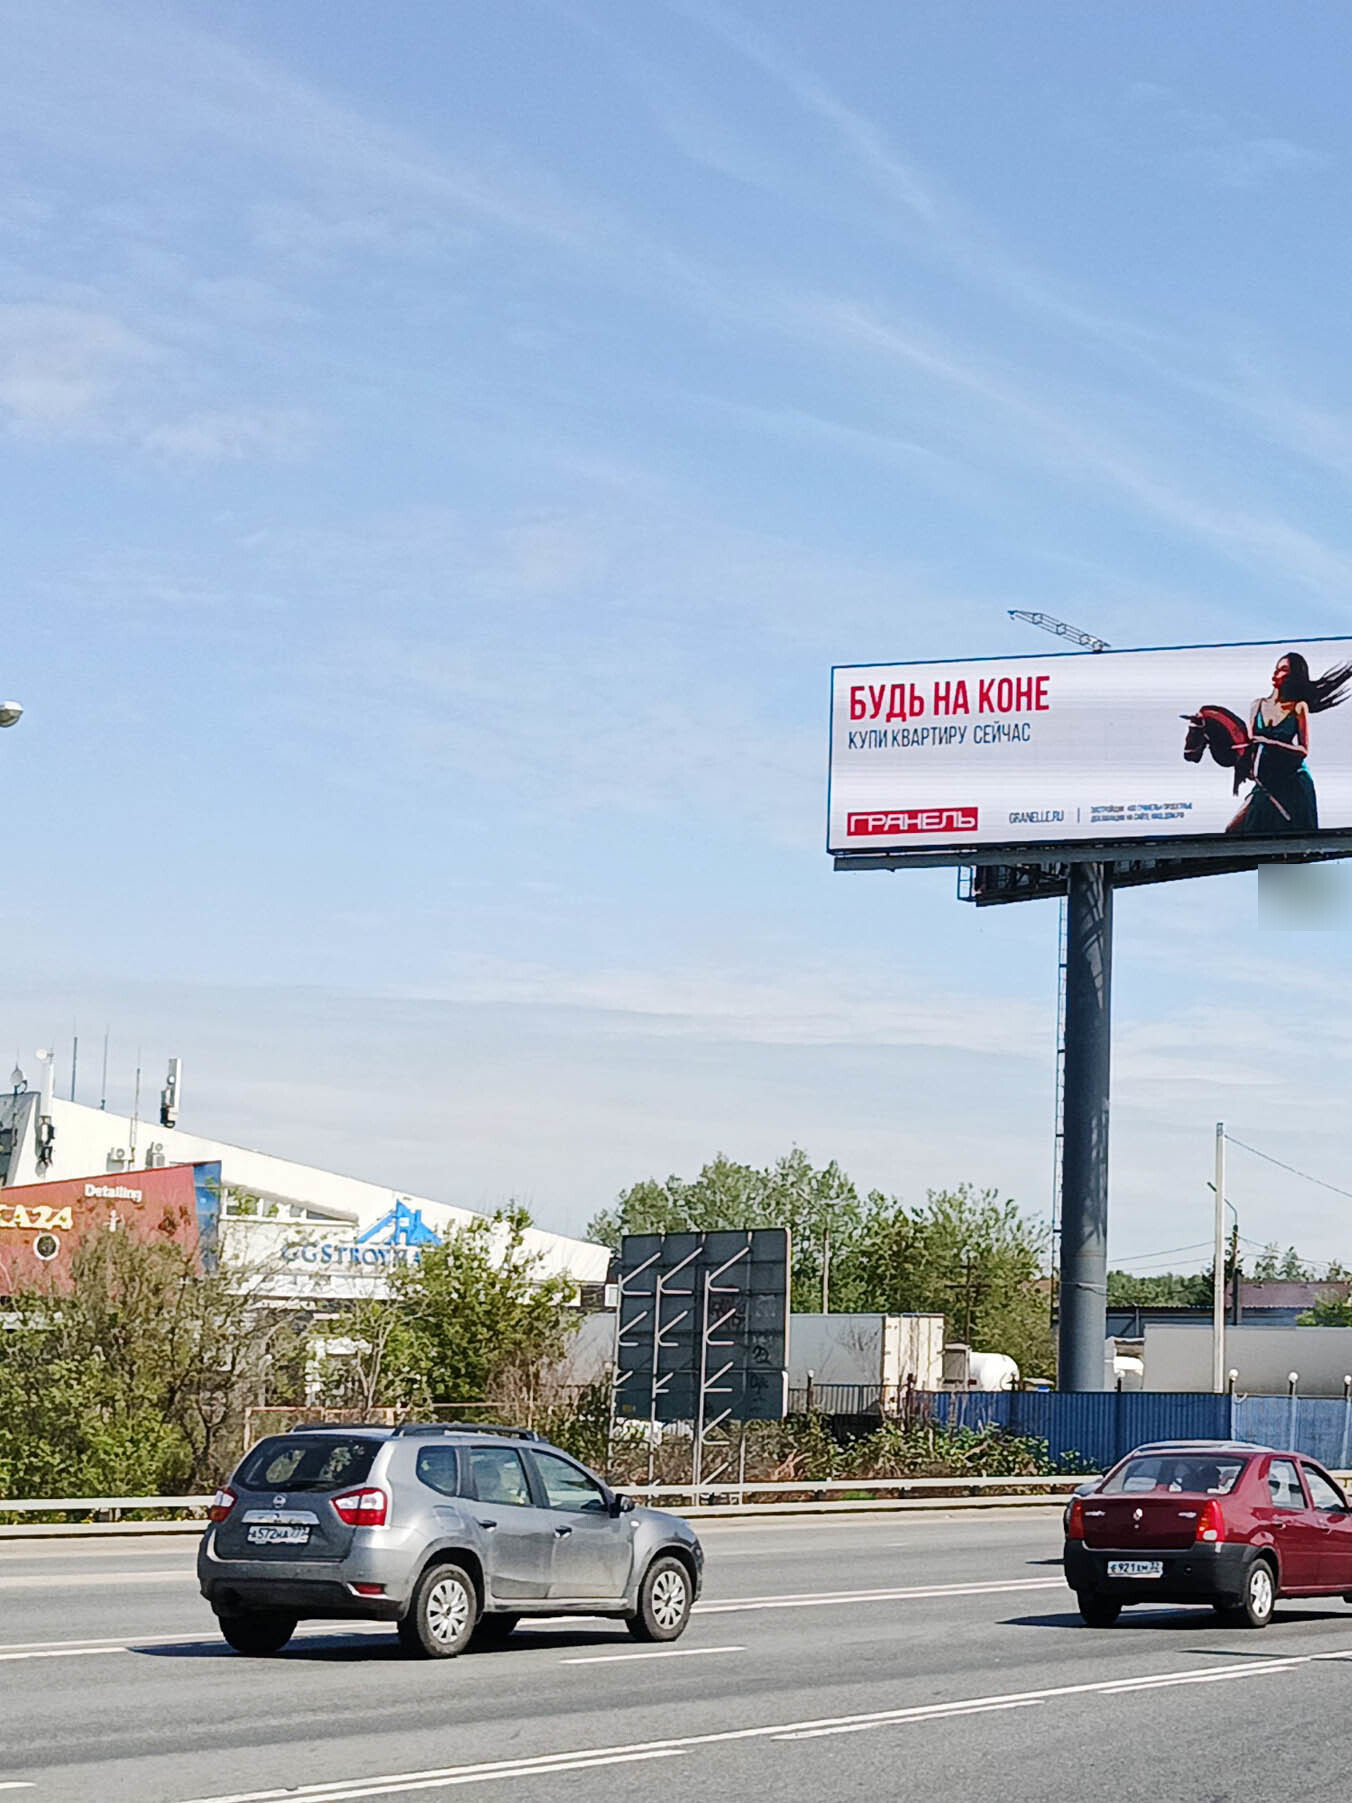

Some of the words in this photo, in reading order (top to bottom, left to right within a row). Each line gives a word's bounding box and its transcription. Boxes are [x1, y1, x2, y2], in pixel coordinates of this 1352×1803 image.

[850, 683, 924, 723] БУДЬ
[933, 680, 969, 715] НА
[978, 676, 1050, 713] КОНЕ
[848, 729, 888, 750] КУПИ
[891, 726, 967, 748] КВАРТИРУ
[973, 720, 1031, 744] СЕЙЧАС
[850, 811, 976, 832] ГРАНЕЛЬ
[84, 1183, 142, 1202] Detailing
